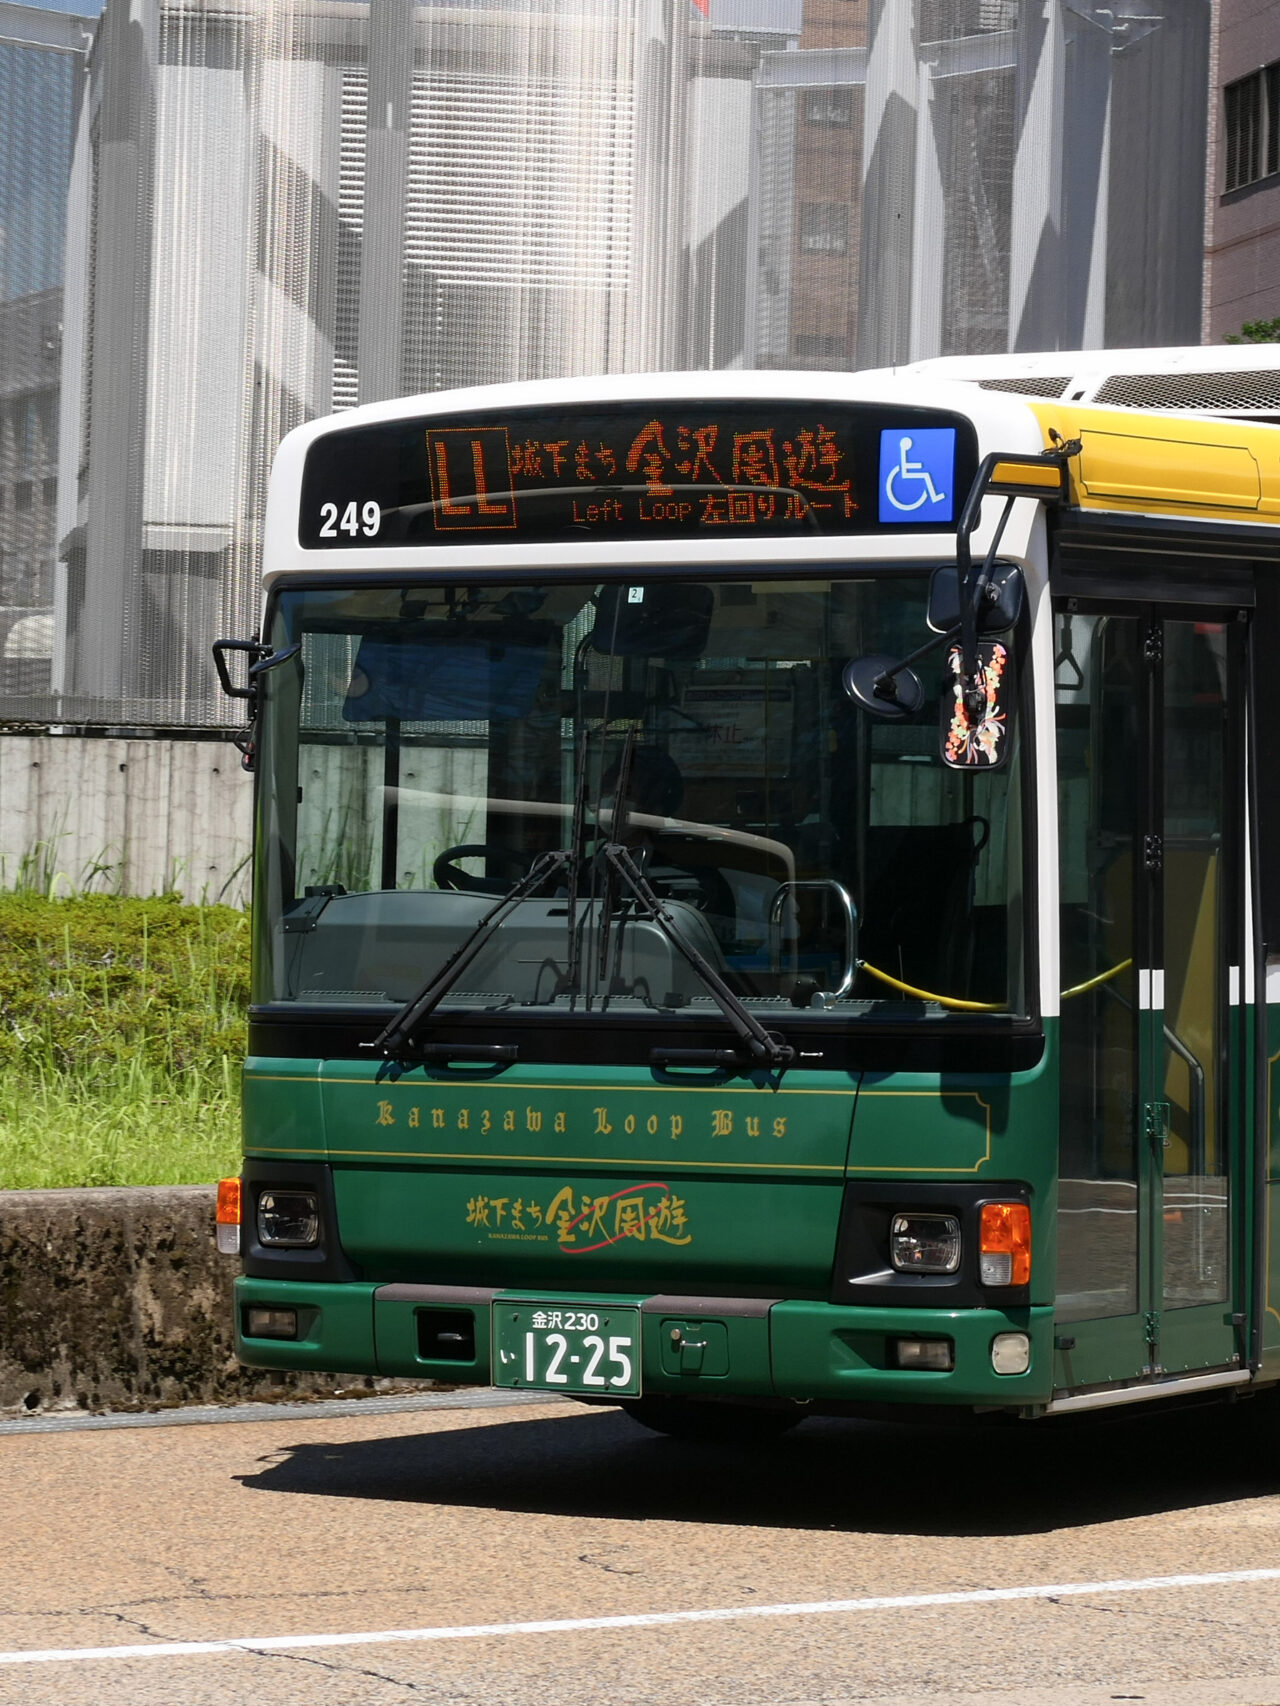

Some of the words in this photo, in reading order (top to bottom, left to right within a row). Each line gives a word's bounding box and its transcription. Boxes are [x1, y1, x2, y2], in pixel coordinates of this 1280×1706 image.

[434, 440, 507, 514] LL
[319, 500, 381, 538] 249
[572, 499, 624, 521] Left
[639, 499, 693, 521] Loop
[699, 493, 859, 524] 左回りルート
[375, 1099, 566, 1136] Kanazawa
[593, 1107, 683, 1140] Loop
[711, 1109, 788, 1138] Bus
[465, 1185, 692, 1246] 城下まち金沢周遊
[532, 1311, 599, 1331] 金沢230
[500, 1349, 515, 1364] い
[526, 1332, 632, 1387] 12-25
